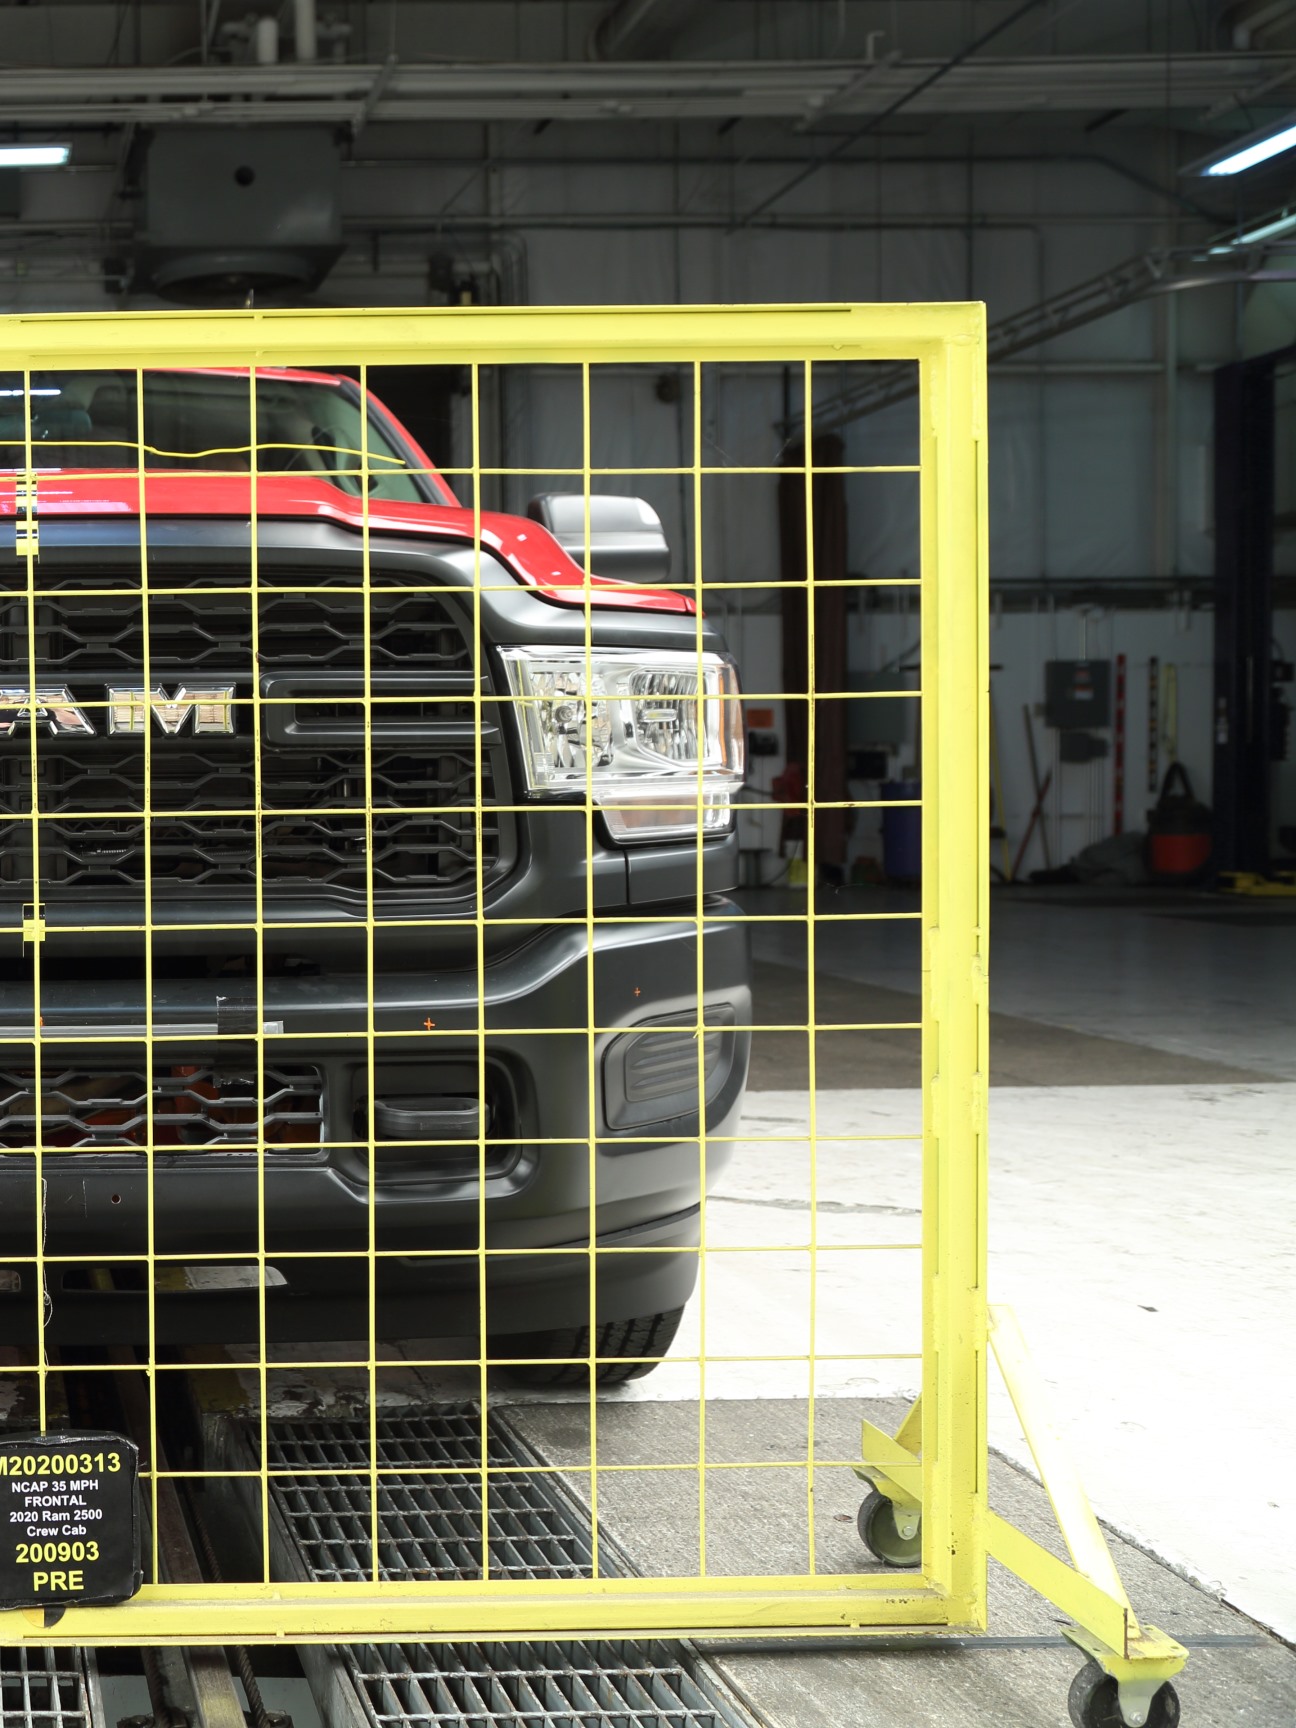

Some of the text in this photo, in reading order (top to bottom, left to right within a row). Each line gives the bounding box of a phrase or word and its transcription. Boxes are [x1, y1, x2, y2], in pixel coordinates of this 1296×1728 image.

[11, 1479, 99, 1493] NCAP 35 MPH
[24, 1495, 87, 1507] FRONTAL
[9, 1509, 103, 1522] 2020 Ram 2500
[26, 1524, 87, 1537] Crew Cab
[15, 1541, 100, 1563] 200903
[33, 1570, 84, 1591] PRE
